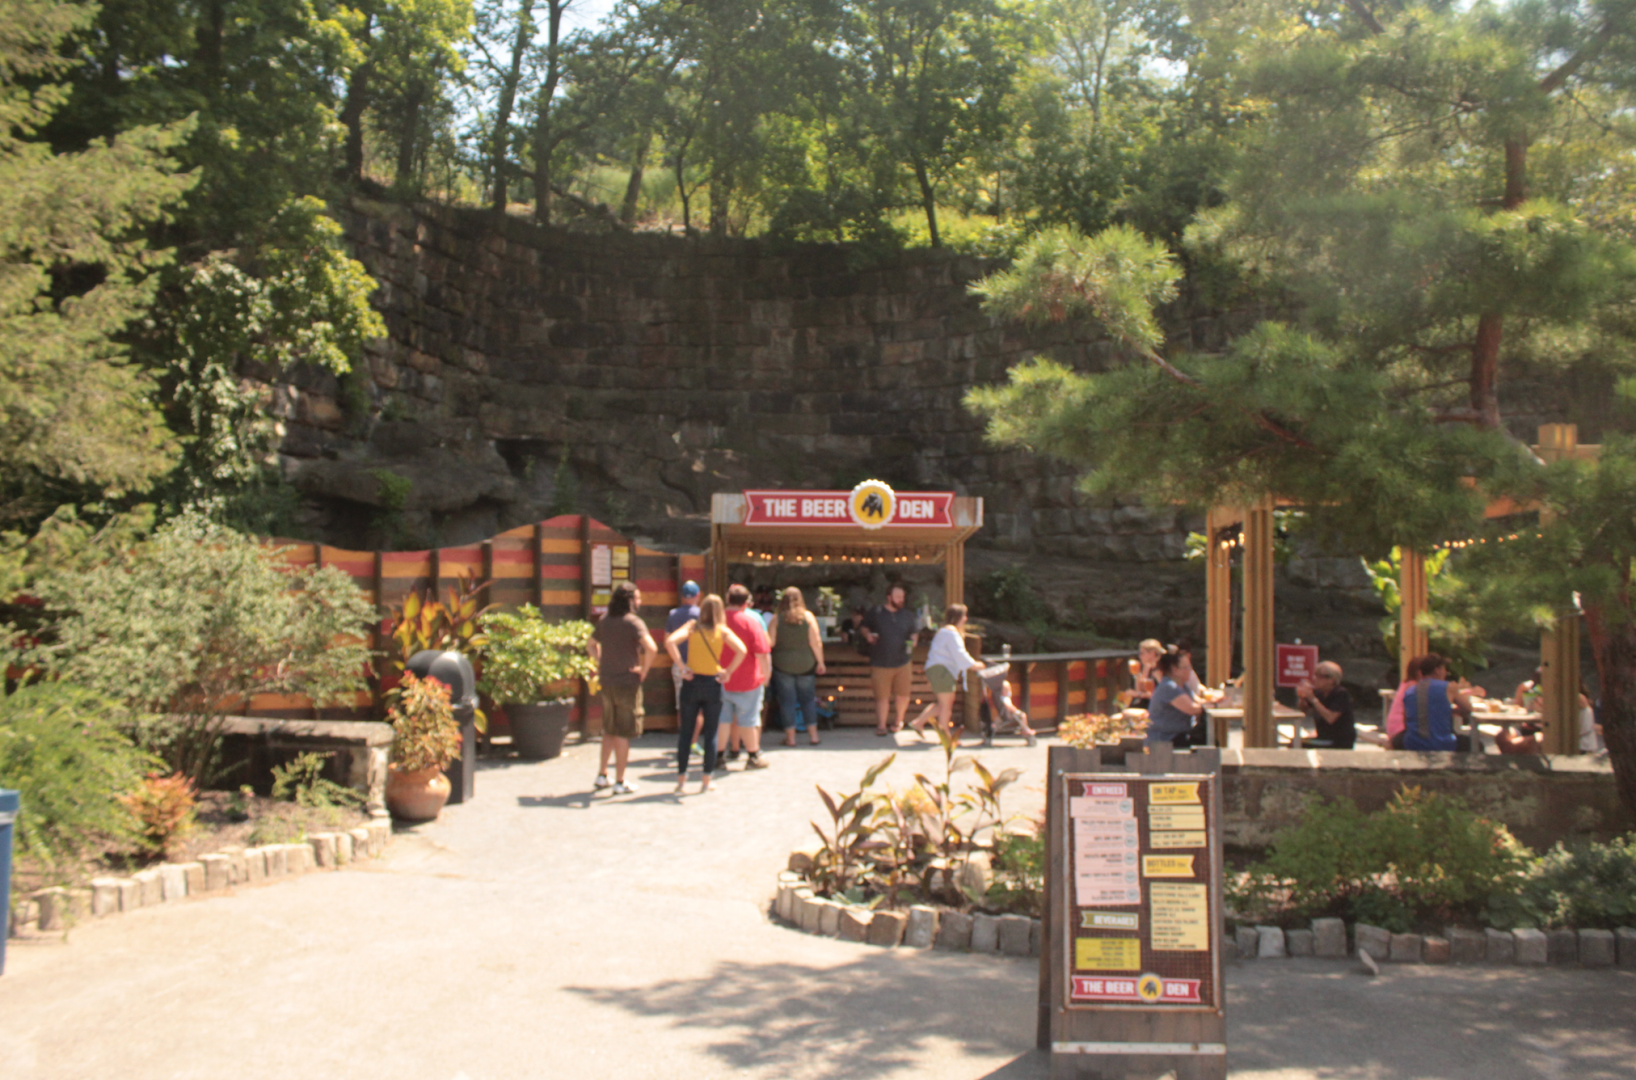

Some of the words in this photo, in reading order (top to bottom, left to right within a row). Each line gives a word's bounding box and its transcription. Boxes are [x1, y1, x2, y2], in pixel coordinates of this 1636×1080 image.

[763, 498, 797, 517] THE
[801, 499, 847, 518] BEER
[900, 500, 934, 518] DEN
[1092, 785, 1124, 795] ENTREES
[1153, 787, 1162, 795] ON
[1164, 786, 1176, 794] TAP
[1147, 859, 1176, 868] BOTTLES
[1093, 914, 1136, 926] BEVERAGES
[1082, 980, 1103, 993] THE
[1105, 981, 1134, 994] BEER
[1166, 982, 1189, 996] DEN
